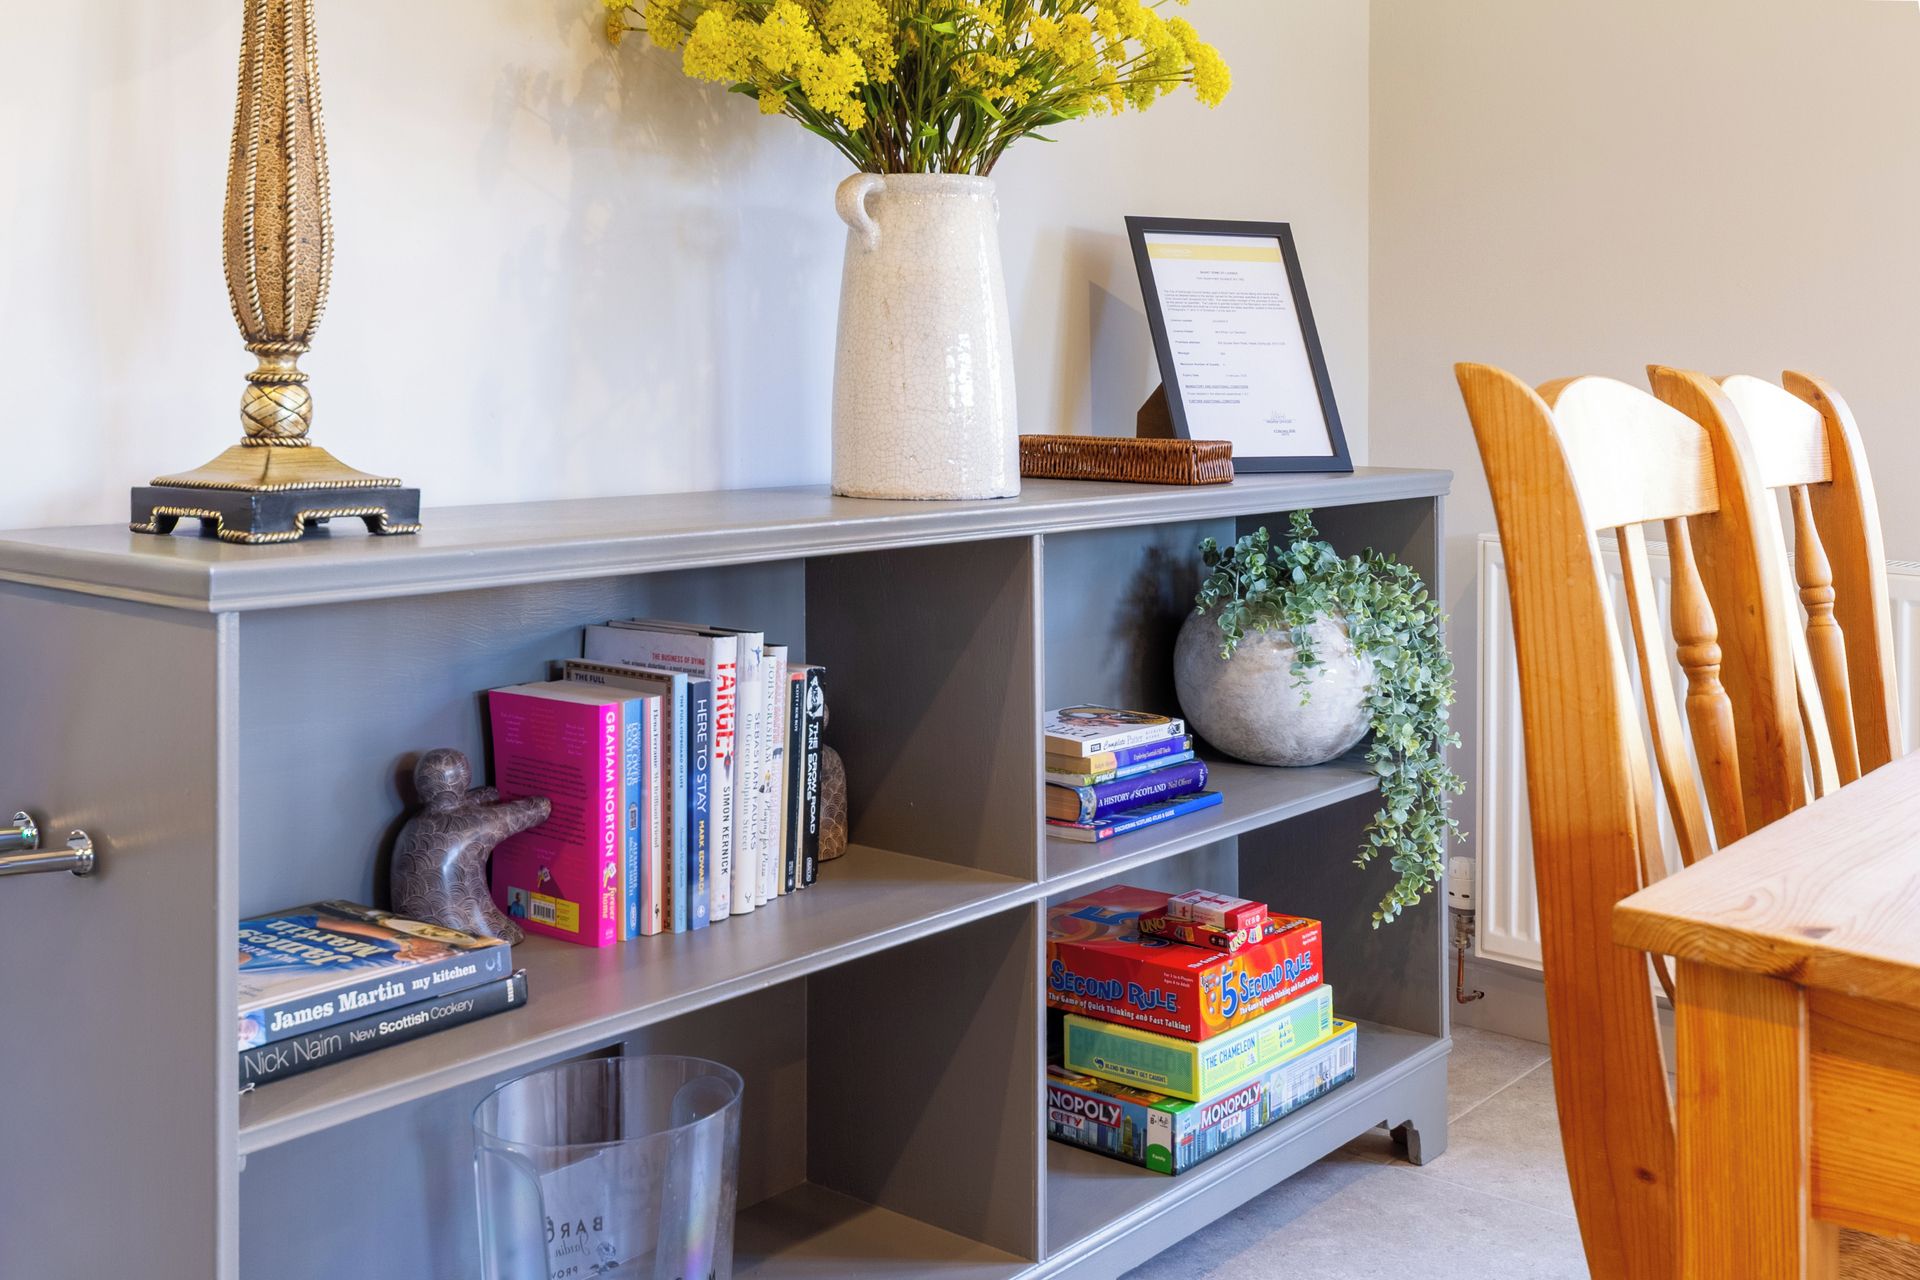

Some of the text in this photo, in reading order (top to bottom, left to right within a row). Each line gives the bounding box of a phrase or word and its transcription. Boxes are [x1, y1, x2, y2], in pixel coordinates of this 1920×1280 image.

[652, 652, 660, 660] THE
[661, 653, 684, 664] BUSINESS
[691, 657, 705, 665] DYING
[574, 673, 606, 684] THE FULL
[716, 663, 736, 758] TARGET
[746, 713, 753, 730] On
[631, 722, 640, 748] LOVE
[765, 703, 774, 763] GRISHAM
[696, 699, 707, 813] HERE TO STAY
[605, 711, 616, 857] GRAHAM NORTON
[742, 771, 751, 815] Dolphin
[1098, 799, 1104, 807] A
[1104, 792, 1130, 806] HISTORY
[1135, 784, 1167, 798] SCOTLAND
[721, 785, 730, 875] SIMON KERNICK
[608, 886, 617, 921] forever
[266, 920, 389, 958] Martin
[1139, 918, 1165, 934] UNO
[1229, 929, 1248, 952] UNO
[270, 963, 478, 1032] James Martin my kitchen
[1050, 959, 1124, 1001] SECOND
[1127, 982, 1177, 1013] RULE
[1221, 971, 1238, 1018] 5
[1239, 963, 1283, 1004] SECOND
[1284, 950, 1311, 983] RULE
[1240, 1007, 1248, 1015] The
[1247, 1001, 1260, 1012] Game
[1263, 994, 1275, 1007] Quick
[1274, 986, 1291, 1000] Thinking
[1290, 982, 1298, 992] and
[1297, 980, 1306, 989] Fast
[1305, 972, 1319, 984] Talking!
[1048, 992, 1191, 1033] The Game of Quick Thinking and Fast Talking!
[244, 999, 474, 1079] Nick Nairn New Scottish Cookery
[1205, 1036, 1256, 1070] THE CHAMELEON
[1049, 1088, 1121, 1125] NOPOLY
[1051, 1110, 1083, 1127] CITY
[1201, 1083, 1260, 1129] MONOPOLY
[1222, 1113, 1240, 1130] CITY
[1152, 1153, 1166, 1162] Family
